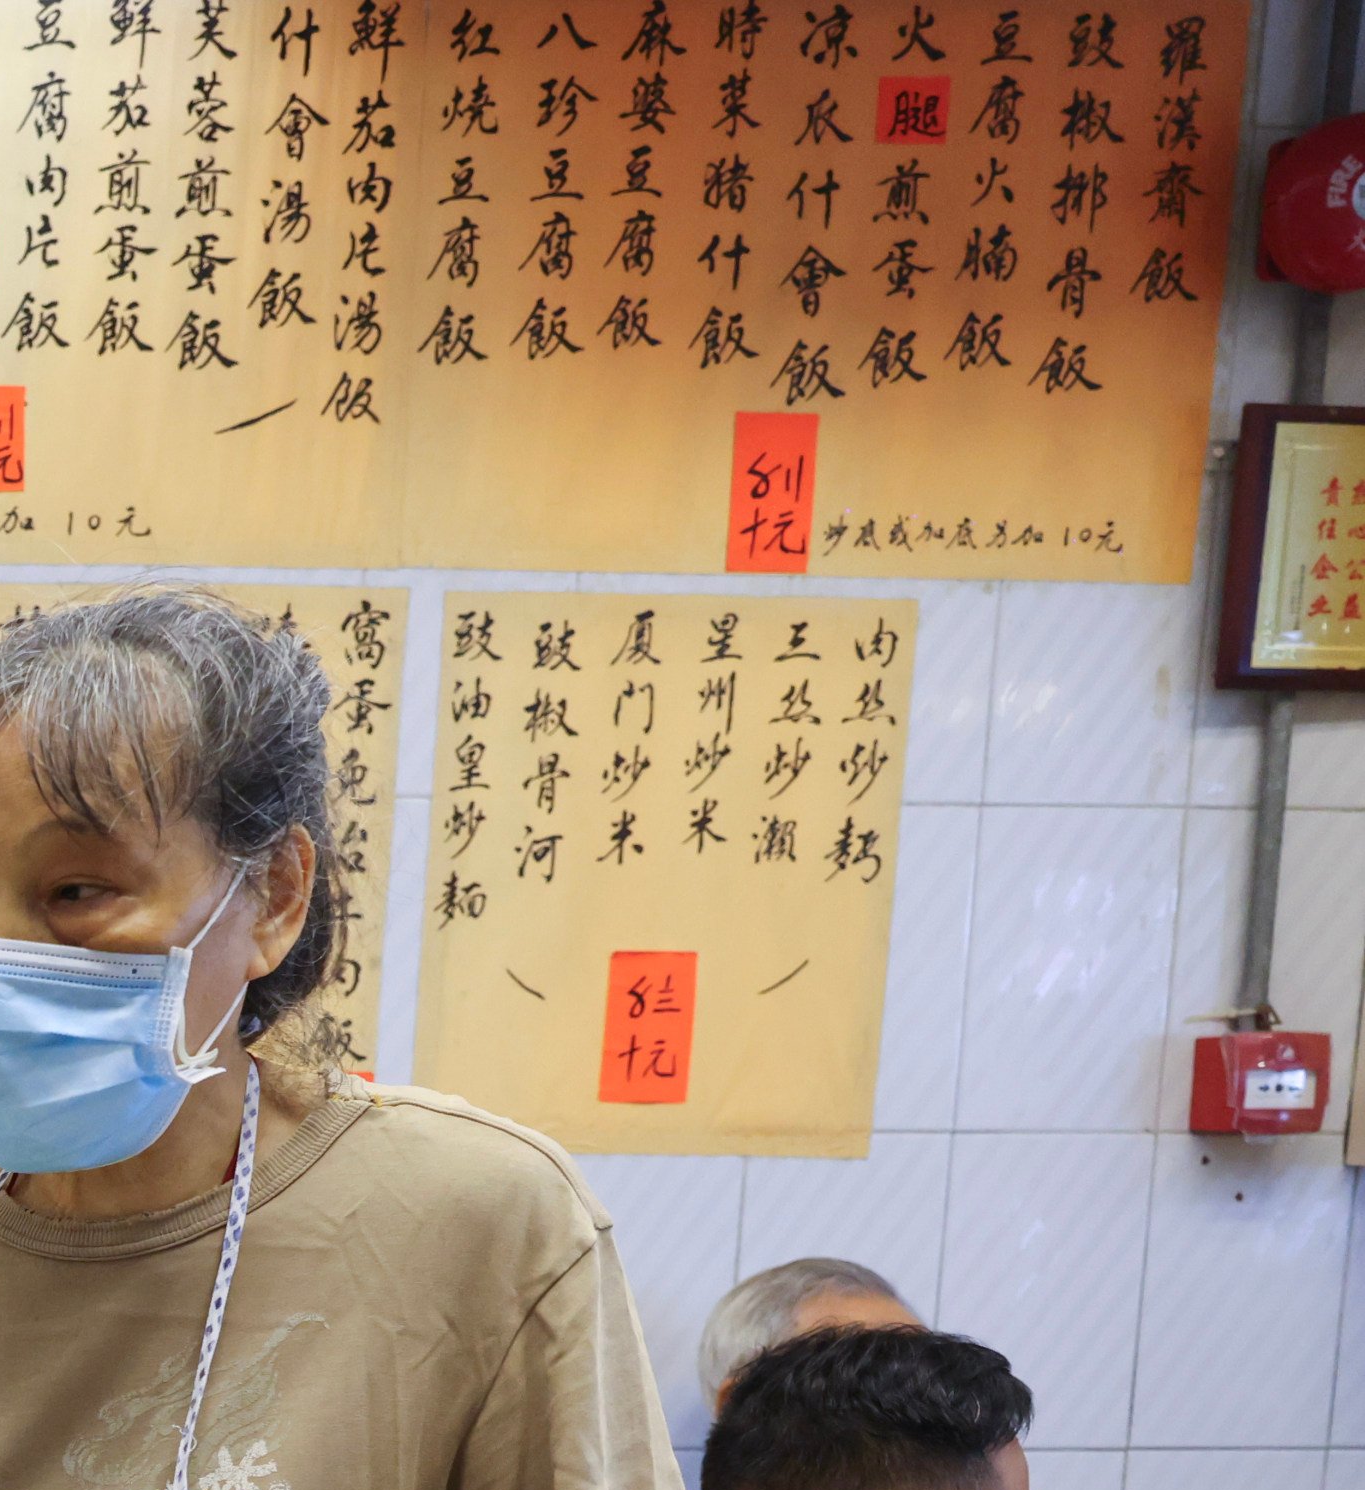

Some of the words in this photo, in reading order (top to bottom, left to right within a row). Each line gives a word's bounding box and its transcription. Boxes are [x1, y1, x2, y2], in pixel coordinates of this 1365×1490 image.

[513, 13, 597, 360] 八珍豆腐飯
